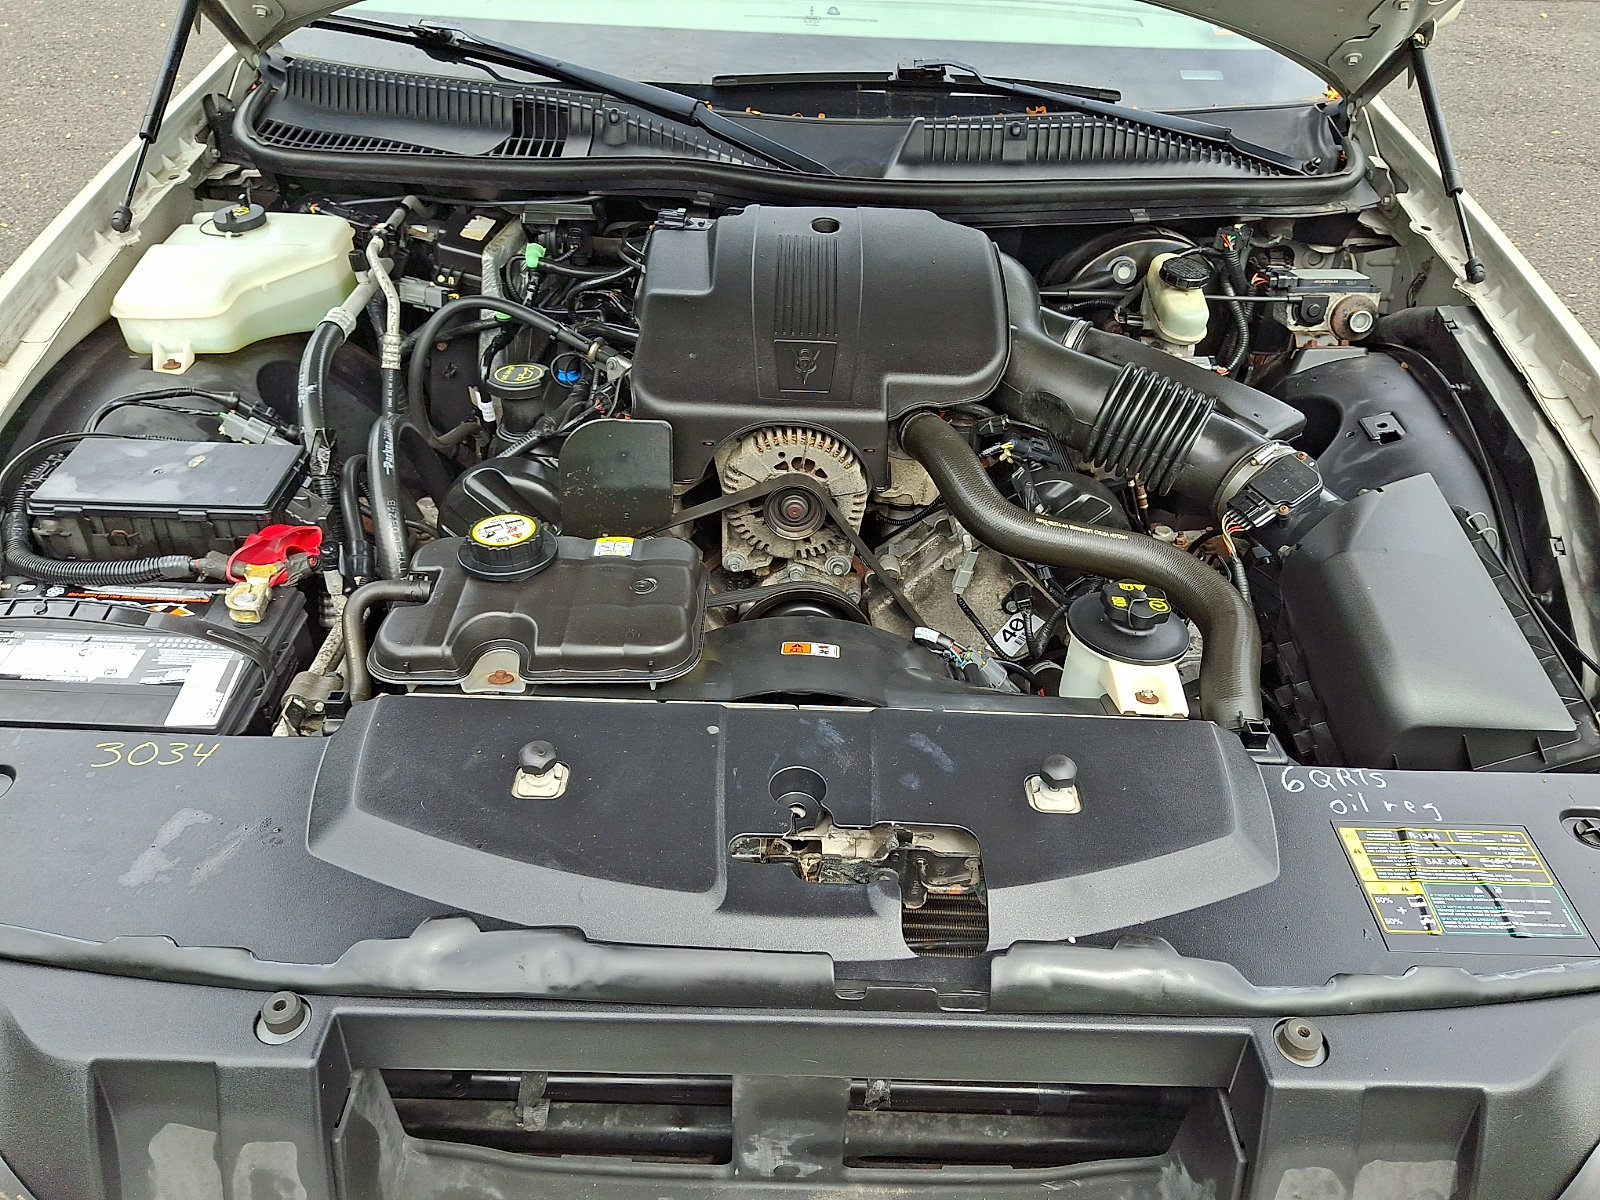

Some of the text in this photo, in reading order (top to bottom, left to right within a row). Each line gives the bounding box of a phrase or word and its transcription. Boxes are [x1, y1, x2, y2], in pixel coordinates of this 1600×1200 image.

[394, 547, 408, 574] TYPE
[90, 741, 220, 768] 3034
[1281, 766, 1305, 793] 6
[1329, 791, 1370, 815] oil
[1407, 831, 1440, 840] R-134A
[1424, 857, 1445, 865] SAE
